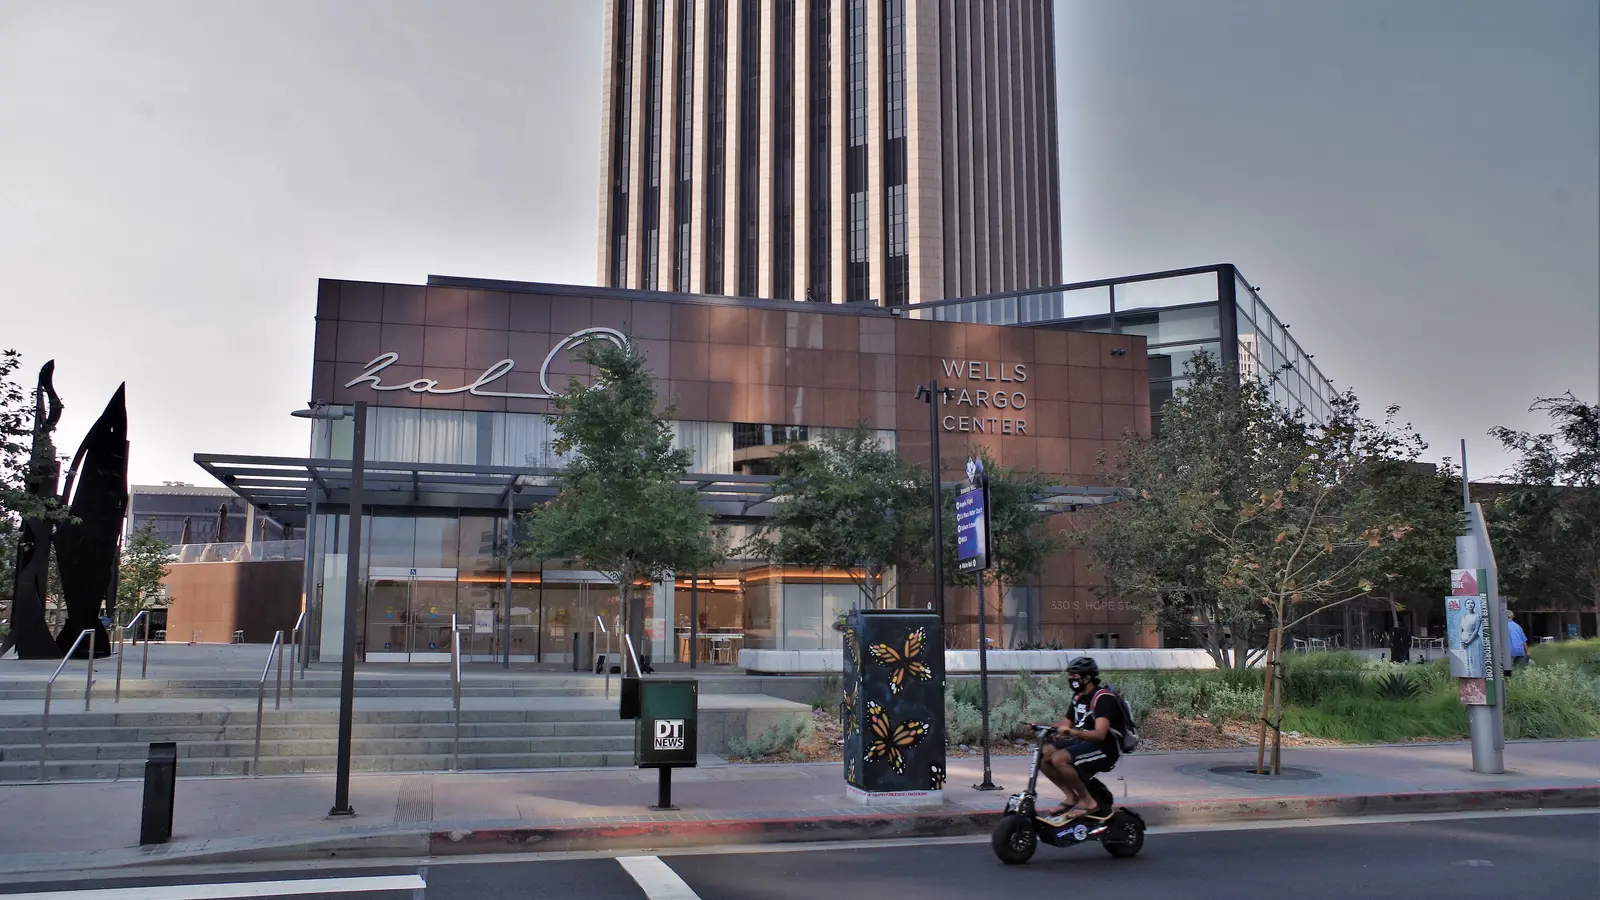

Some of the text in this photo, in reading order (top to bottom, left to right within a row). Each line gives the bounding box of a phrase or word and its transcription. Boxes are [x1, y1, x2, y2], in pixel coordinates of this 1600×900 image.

[942, 360, 1027, 382] WELLS
[943, 387, 1027, 409] FARGO
[943, 415, 1027, 434] CENTER
[1051, 600, 1070, 610] 330
[1086, 601, 1115, 611] HOPE
[1482, 618, 1490, 630] HILL
[1483, 637, 1493, 664] HISTORIC
[1486, 665, 1494, 681] CORE
[656, 720, 683, 738] DT
[655, 738, 683, 747] NEWS
